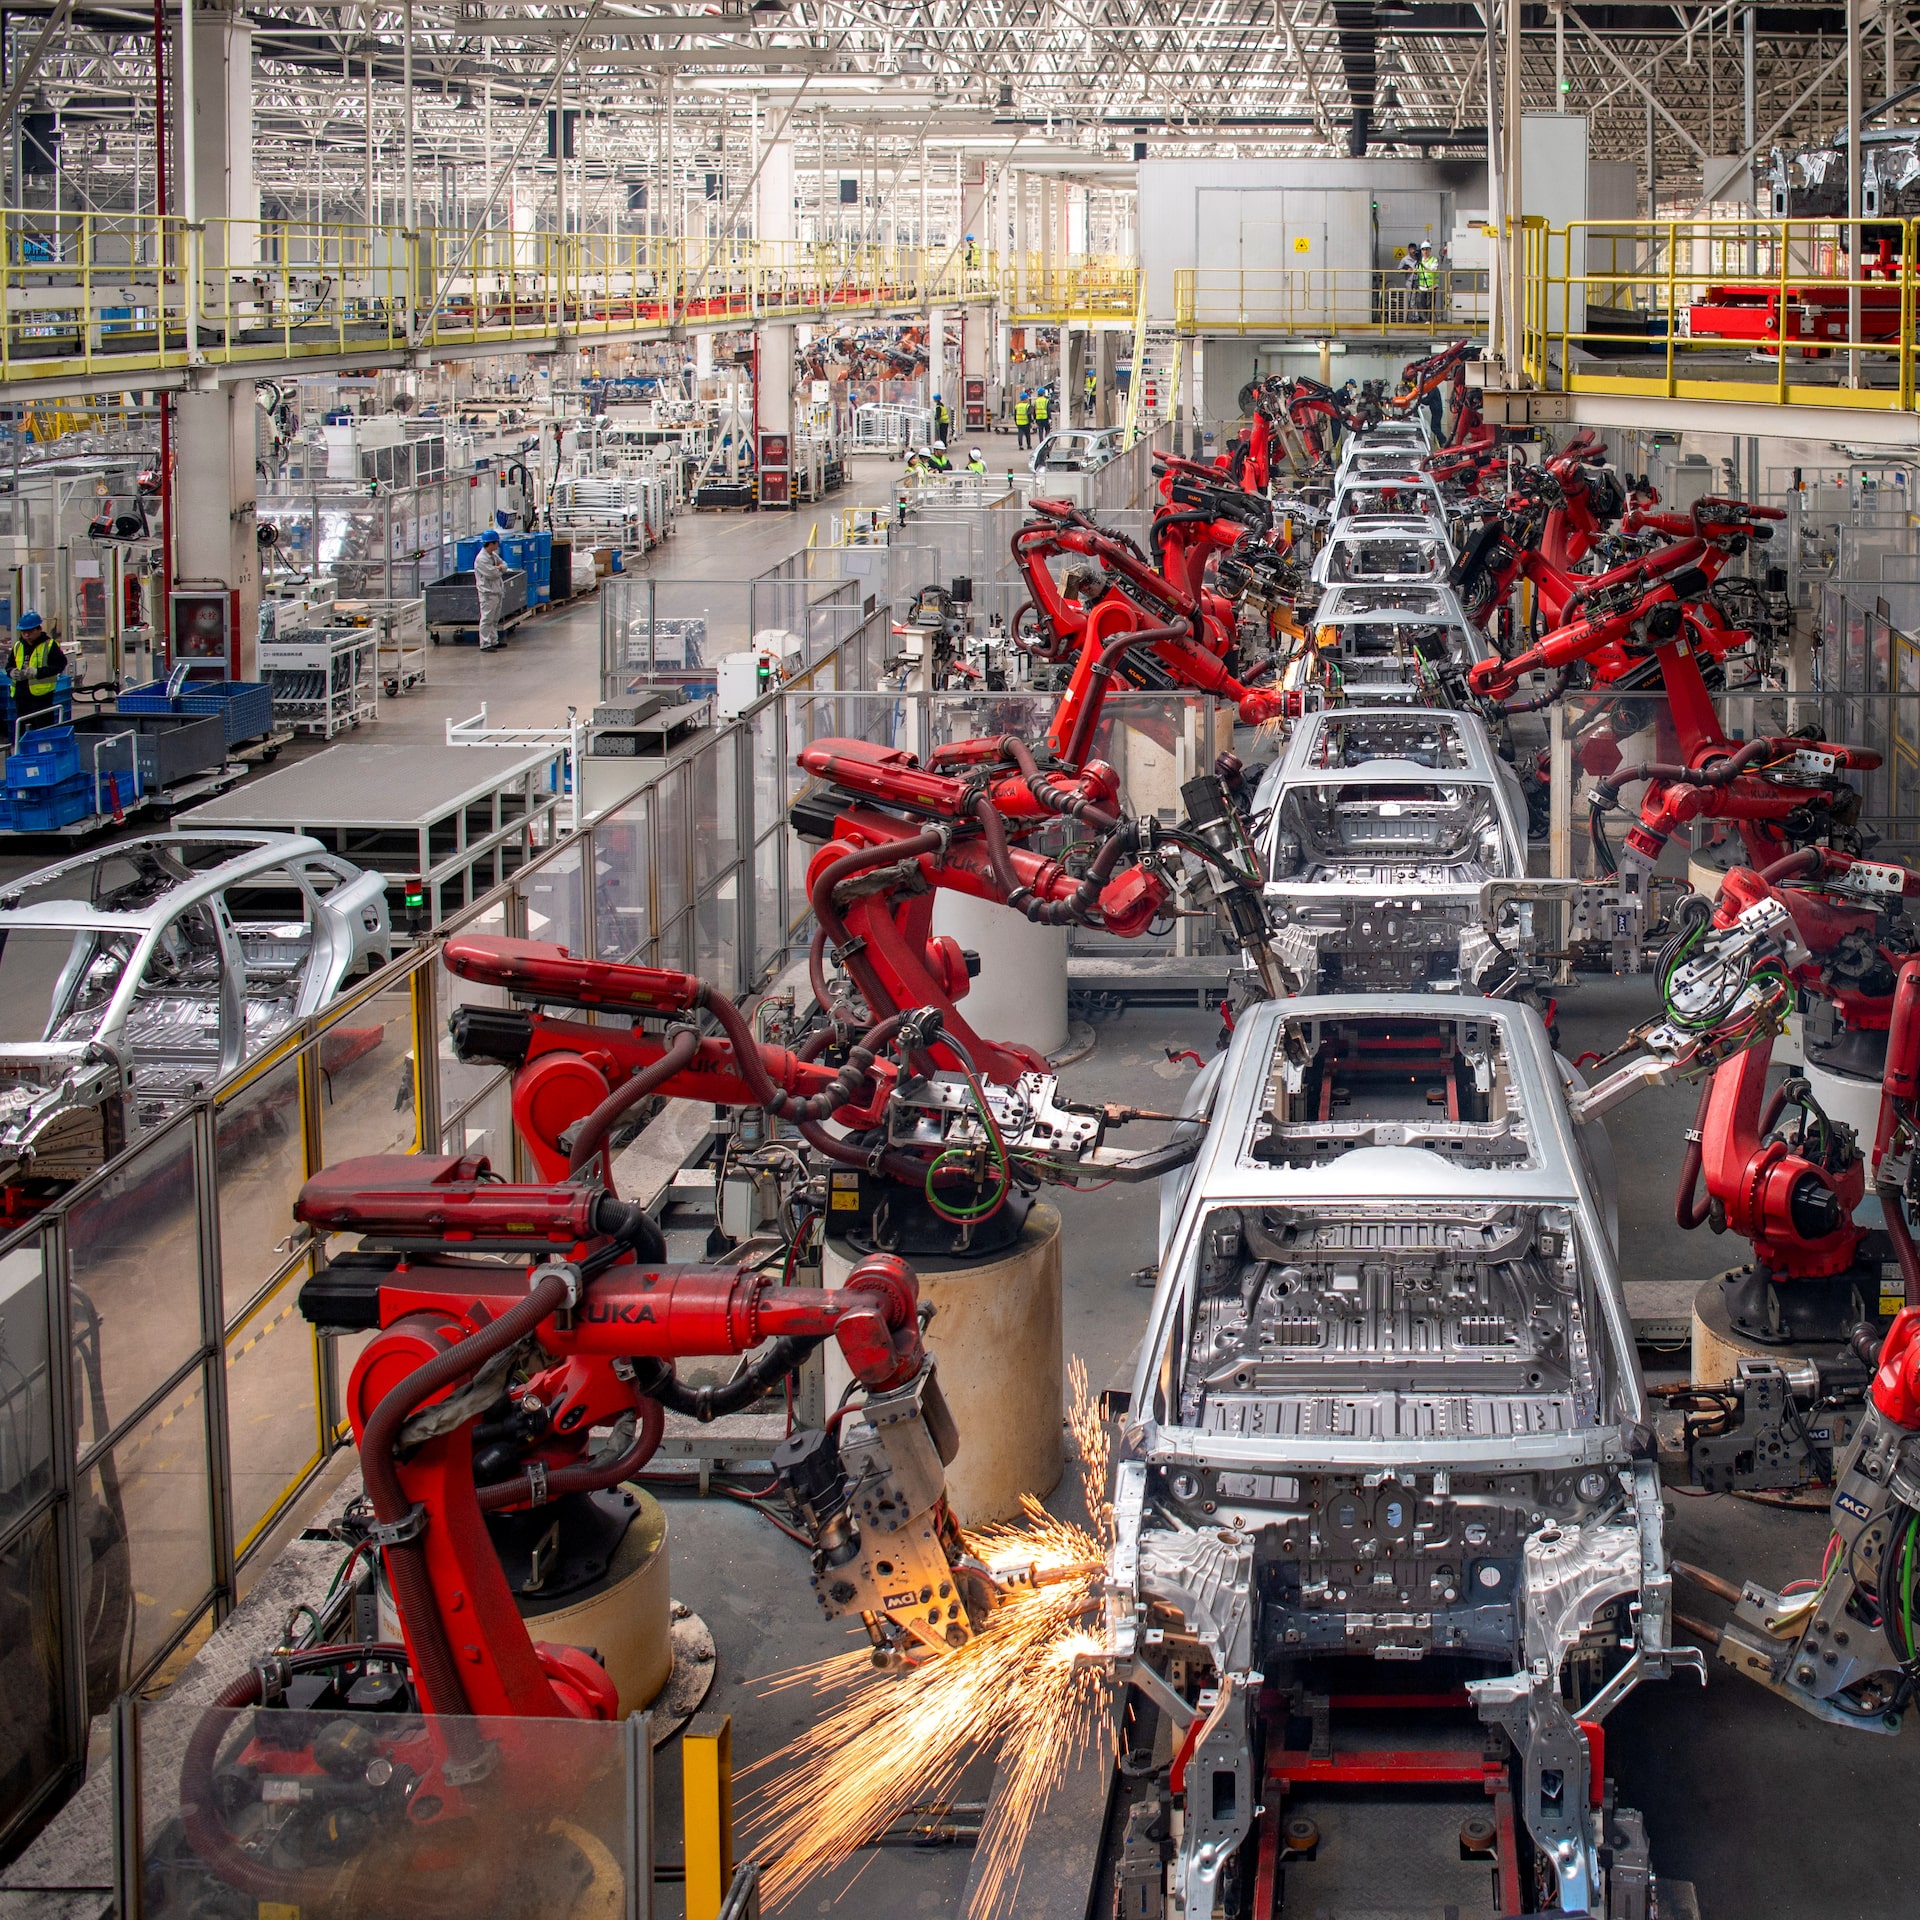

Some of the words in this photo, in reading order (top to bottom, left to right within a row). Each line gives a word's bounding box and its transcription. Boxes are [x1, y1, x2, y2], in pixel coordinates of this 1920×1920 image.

[1458, 551, 1471, 568] KUKA
[1570, 624, 1606, 644] KUKA
[1128, 668, 1148, 685] KUKA
[1641, 673, 1661, 689] KUKA
[1750, 789, 1778, 800] KUKA
[686, 1058, 736, 1077] UKA
